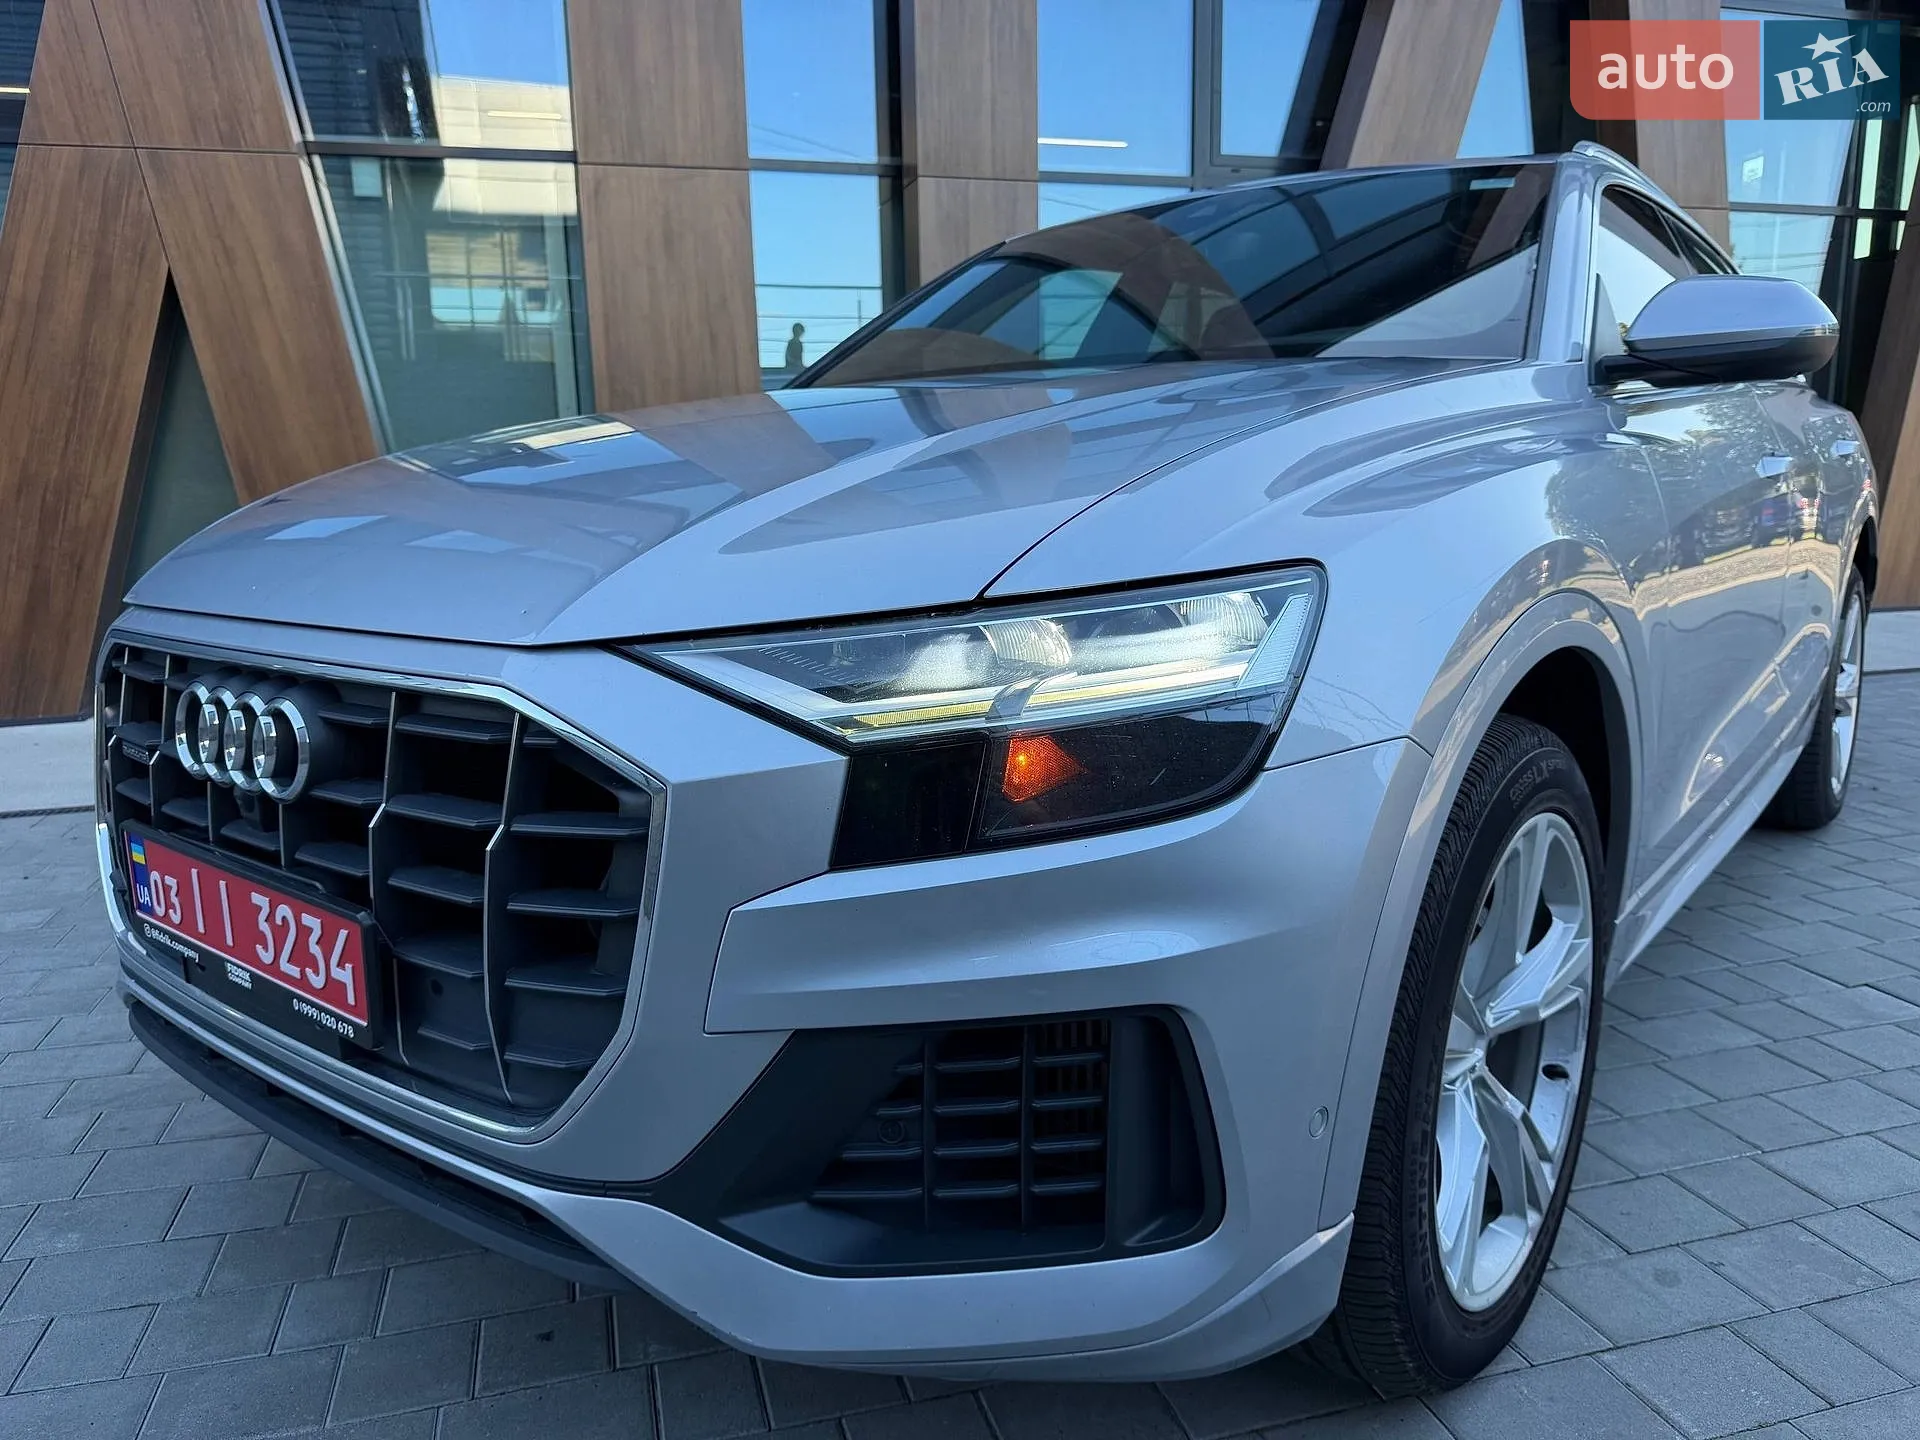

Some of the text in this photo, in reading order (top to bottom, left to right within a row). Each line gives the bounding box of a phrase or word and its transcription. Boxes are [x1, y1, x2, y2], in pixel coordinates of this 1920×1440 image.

[136, 883, 152, 907] UA
[150, 870, 182, 925] 03
[250, 891, 356, 1006] 3234
[320, 1012, 337, 1030] 020
[337, 1020, 355, 1038] 678
